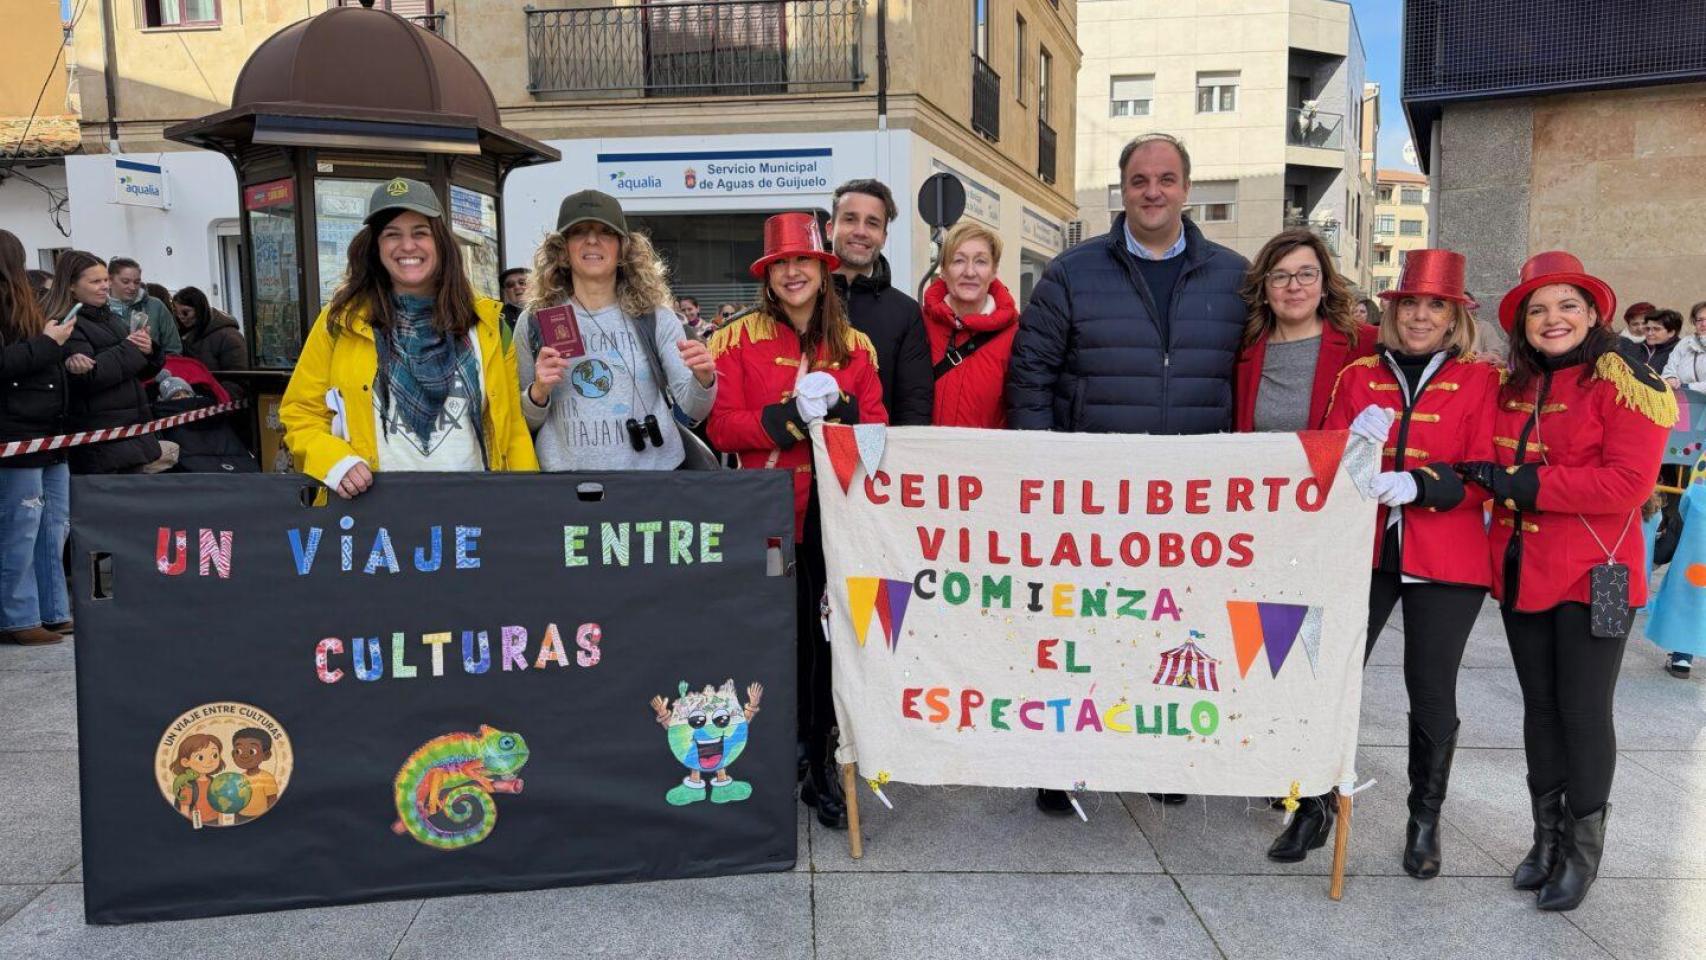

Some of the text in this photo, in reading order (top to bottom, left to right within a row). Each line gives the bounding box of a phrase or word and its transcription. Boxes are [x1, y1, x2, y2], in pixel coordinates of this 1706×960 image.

[617, 176, 661, 191] aqualia
[700, 175, 827, 192] de Aguas de Guijuelo
[707, 161, 817, 175] Servicio Municipal
[126, 184, 159, 196] aqualia
[166, 246, 173, 256] 9
[864, 471, 1329, 513] CEIP FILIBERTO
[155, 526, 234, 579] UN
[564, 520, 725, 568] ENTRE
[917, 526, 1255, 567] VILLALOBOS
[913, 569, 1181, 621] COMIENZA
[315, 622, 603, 684] CULTURAS
[1037, 638, 1092, 673] EL
[164, 705, 282, 746] UN VIAJE ENTRE CULTURAS
[902, 683, 1219, 737] ESPECTÁCULO
